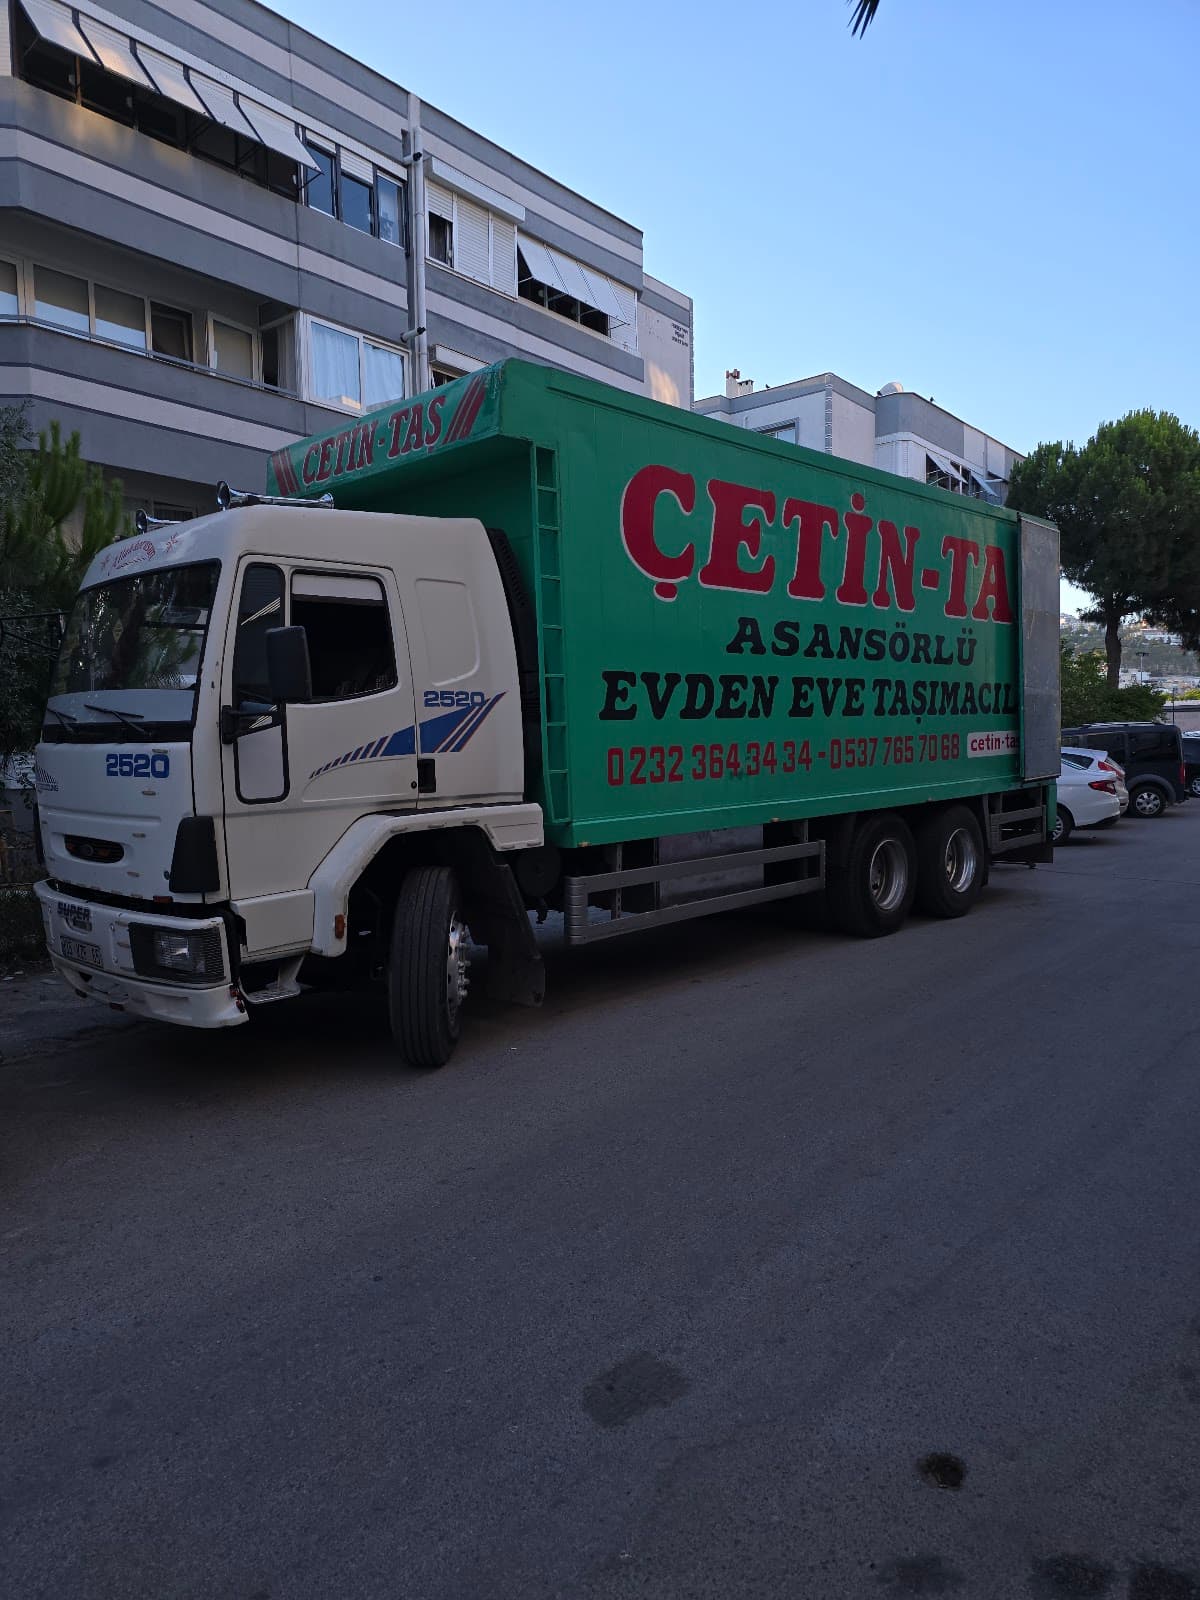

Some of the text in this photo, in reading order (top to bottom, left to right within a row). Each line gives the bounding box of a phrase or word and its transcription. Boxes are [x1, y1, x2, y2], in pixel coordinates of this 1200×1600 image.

[726, 617, 978, 666] ASANSÖRLÜ
[423, 690, 485, 708] 2520
[599, 671, 779, 720] EVDEN
[788, 676, 866, 718] EVE
[105, 753, 170, 779] 2520
[57, 901, 91, 921] SUPER
